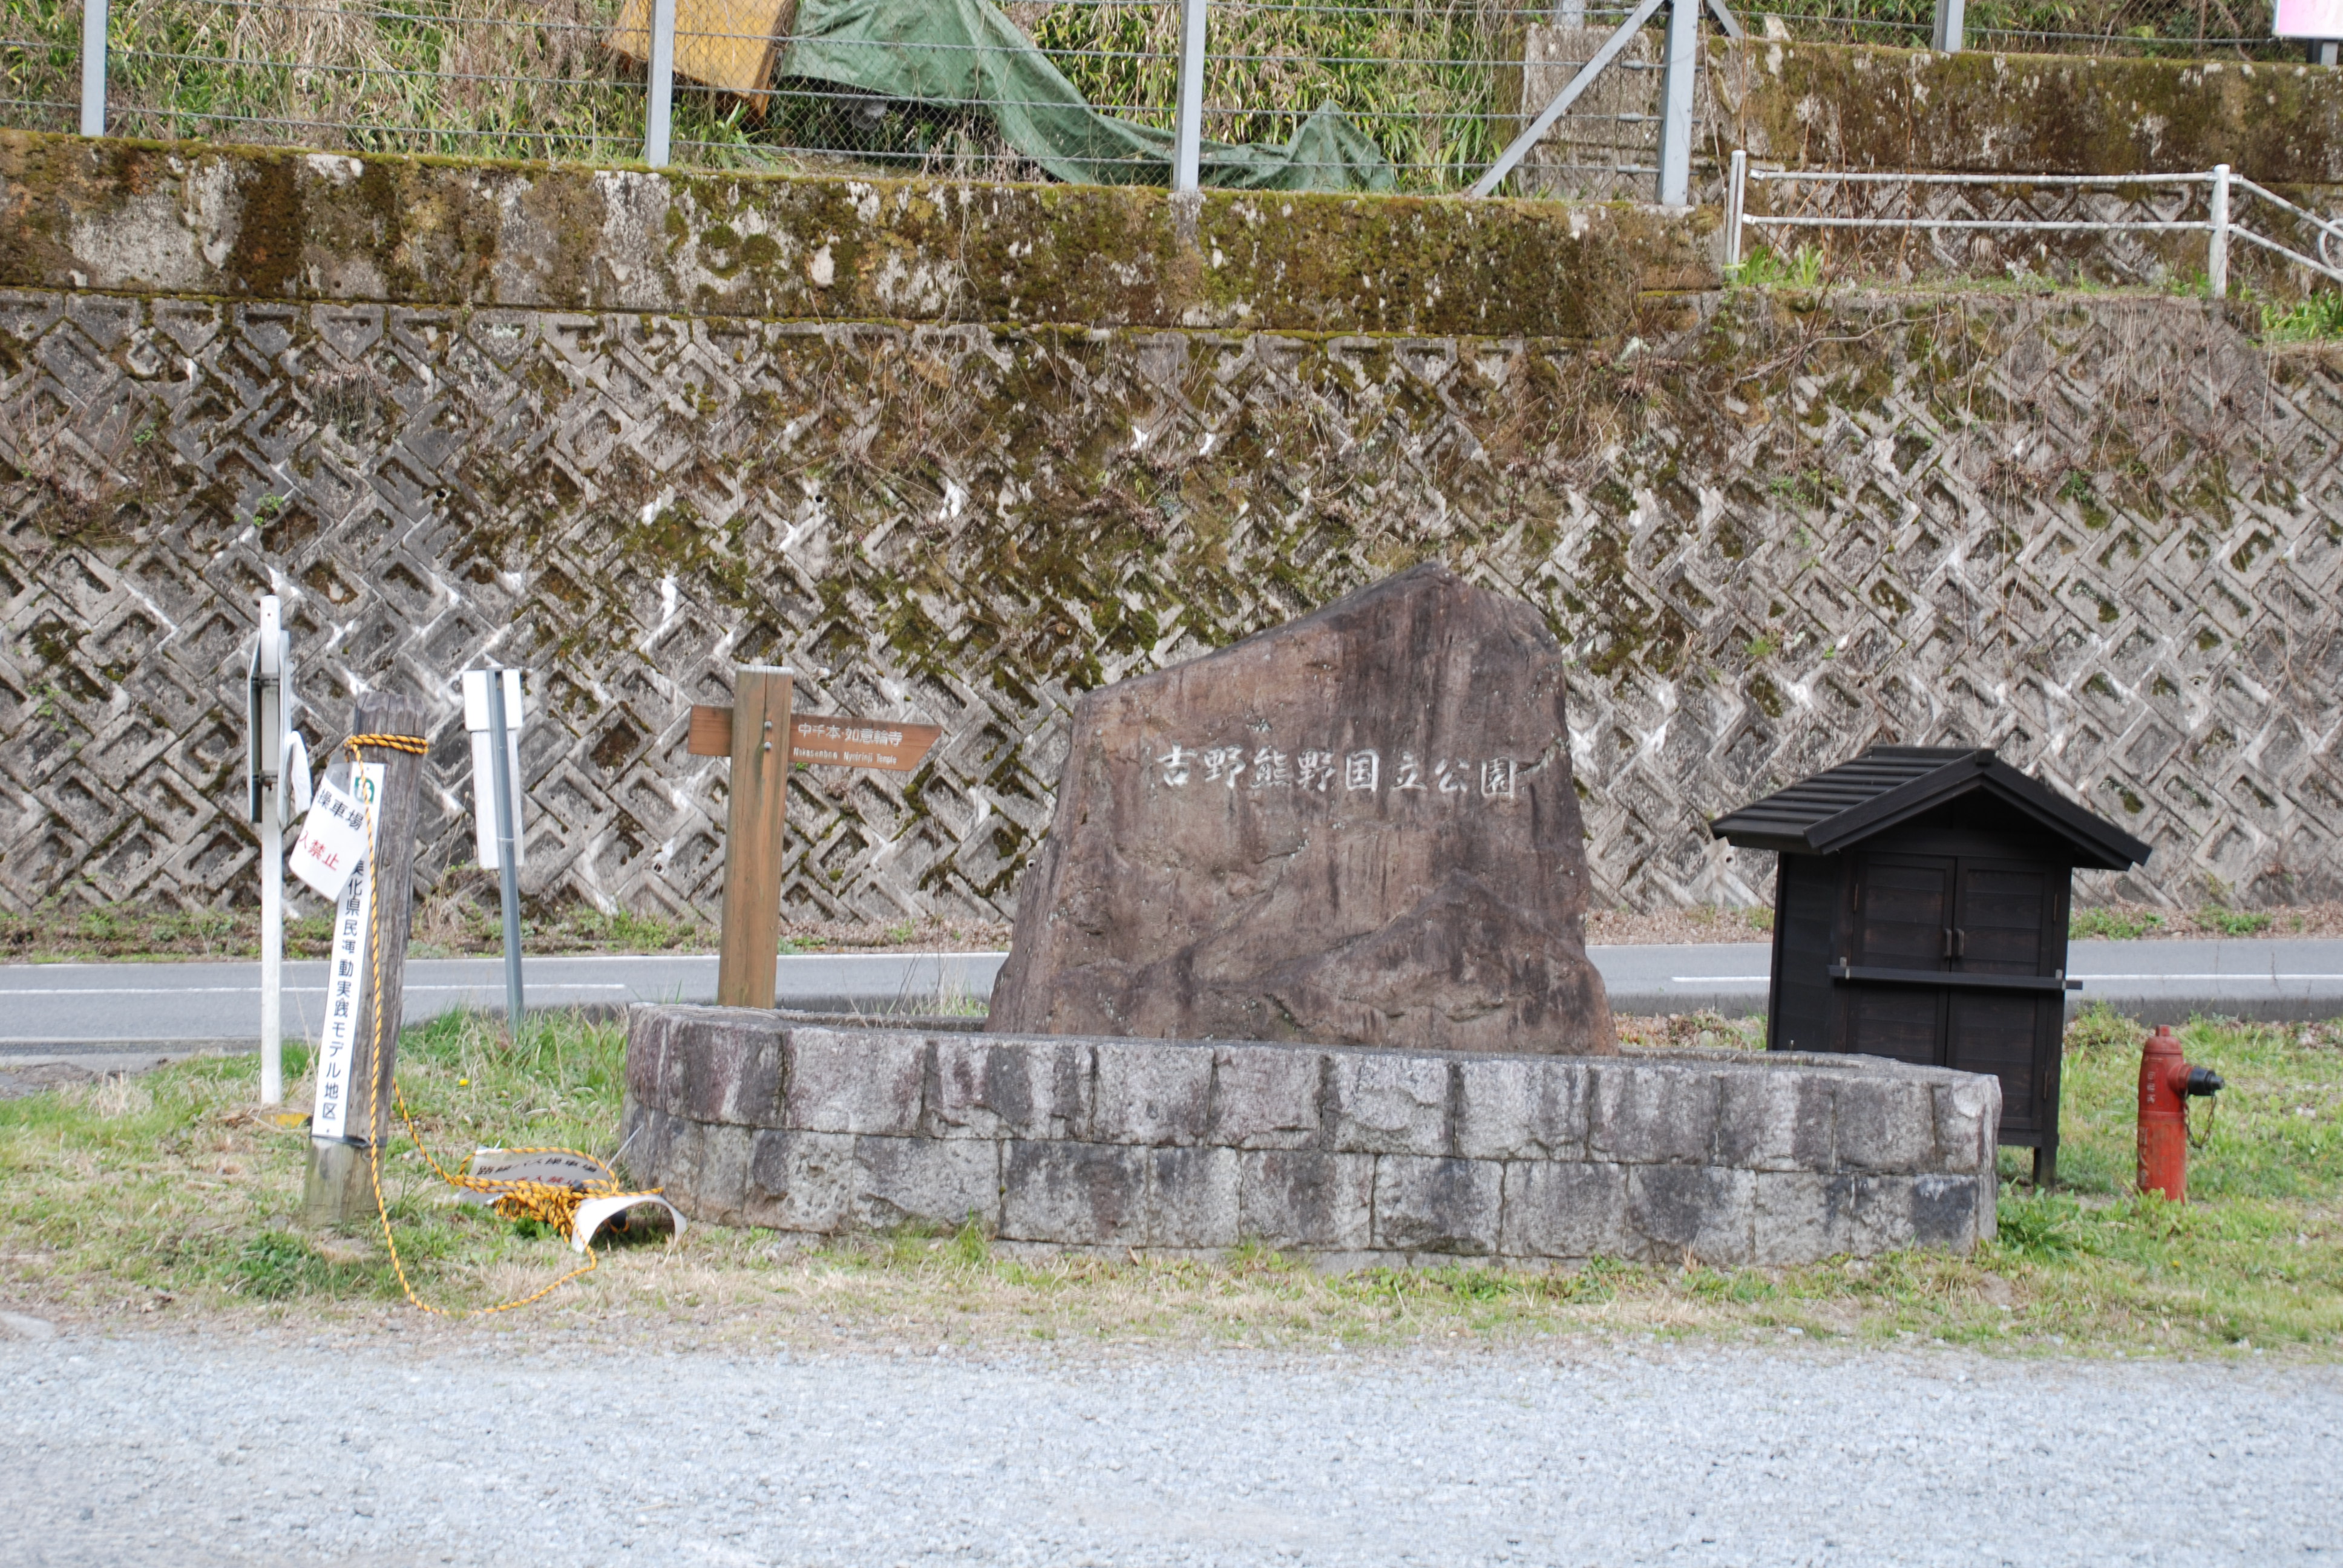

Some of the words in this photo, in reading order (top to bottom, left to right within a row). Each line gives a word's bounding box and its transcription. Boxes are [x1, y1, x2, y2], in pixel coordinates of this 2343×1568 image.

[876, 753, 897, 765] Temple
[1156, 739, 1518, 799] 吉野熊野国立公園
[316, 788, 364, 831] 操車場
